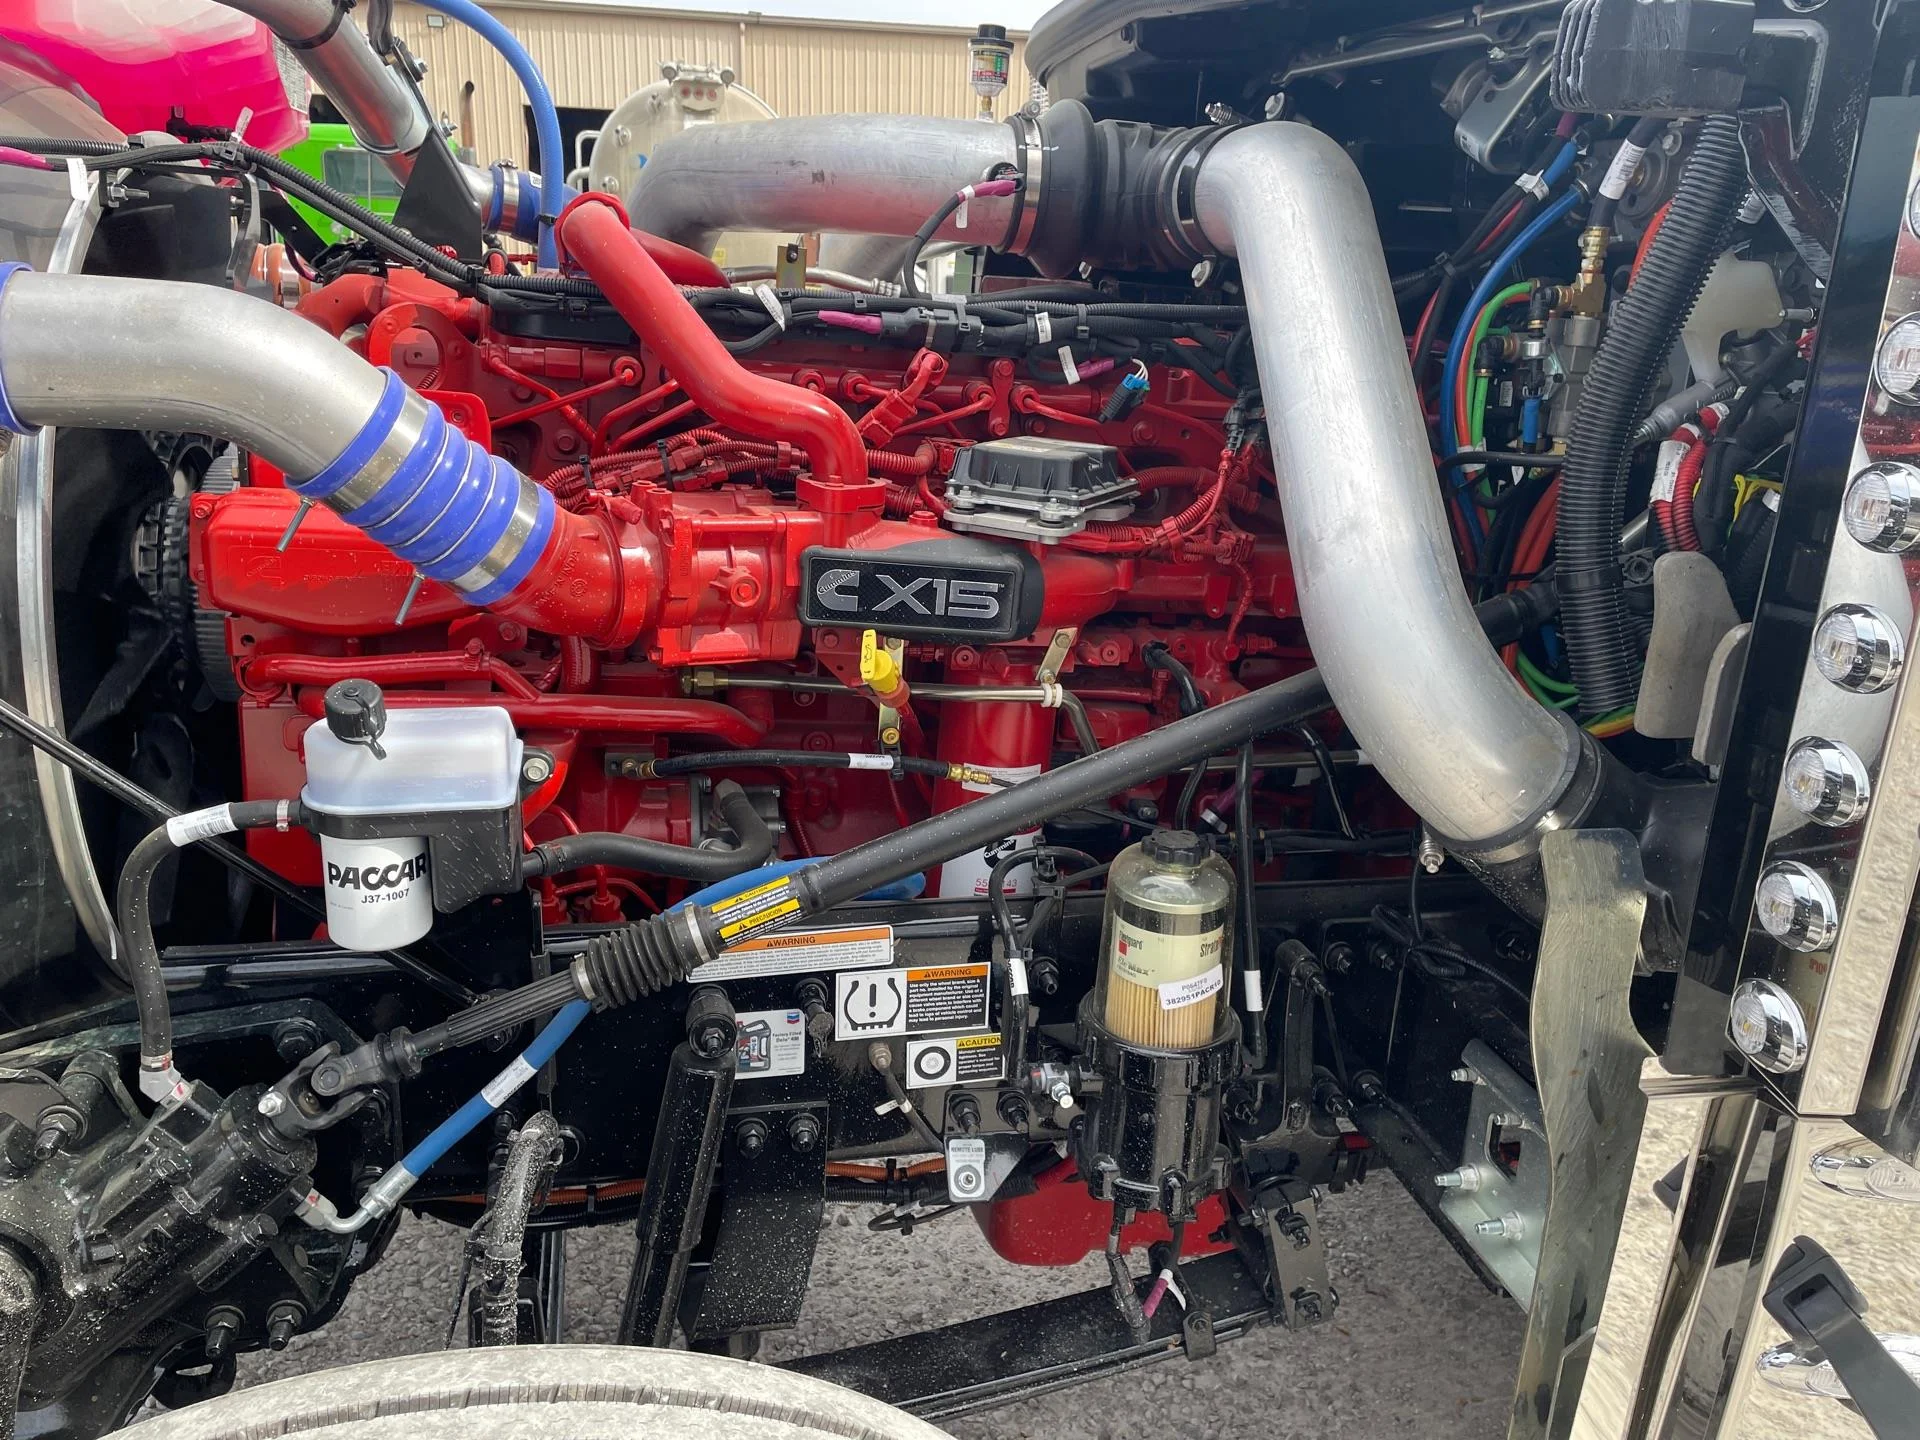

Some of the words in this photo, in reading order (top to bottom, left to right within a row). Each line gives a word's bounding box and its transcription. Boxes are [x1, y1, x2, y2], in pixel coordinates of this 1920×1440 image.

[818, 570, 857, 594] Cummins
[872, 574, 1000, 619] X15
[984, 838, 1014, 859] Cummins
[327, 853, 427, 891] PACCAR
[361, 888, 410, 904] J37-1007
[773, 936, 816, 948] WARNING
[931, 969, 972, 978] WARNING
[965, 1038, 1002, 1046] CAUTION
